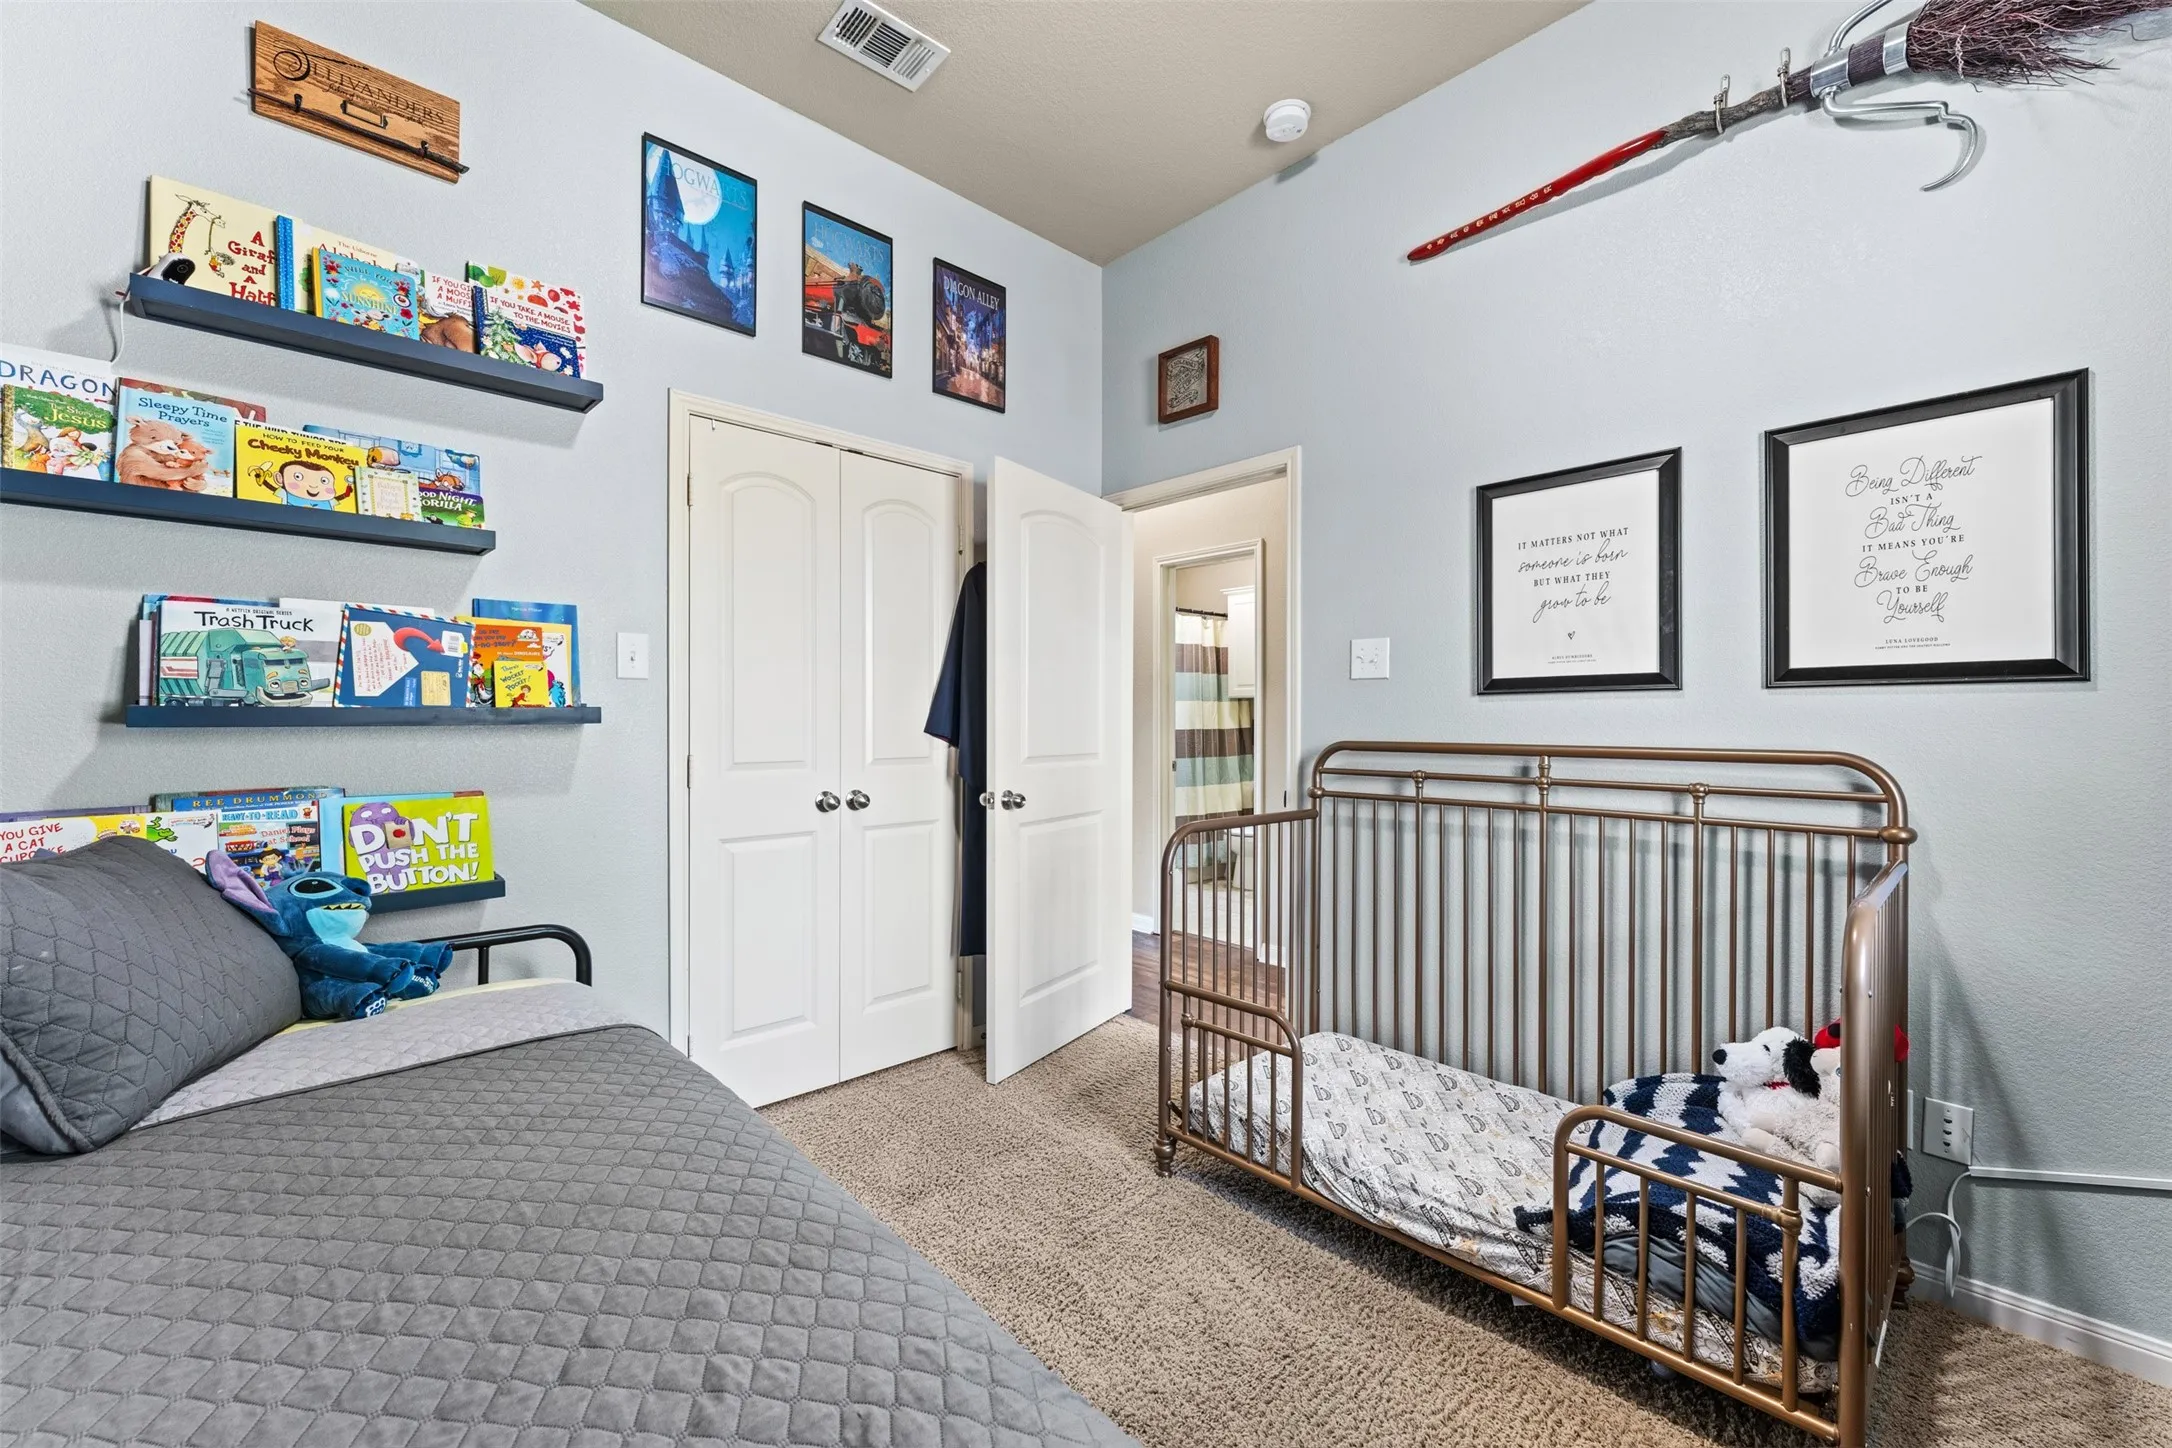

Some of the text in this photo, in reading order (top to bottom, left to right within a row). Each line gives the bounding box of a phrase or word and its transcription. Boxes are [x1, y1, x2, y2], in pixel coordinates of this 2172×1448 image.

[273, 39, 444, 124] OLLIVANDERS
[250, 231, 265, 247] A
[228, 240, 276, 265] Giraf
[242, 264, 266, 276] and
[243, 275, 257, 284] A
[229, 282, 276, 306] Half
[432, 276, 471, 292] IF YOU GI
[446, 288, 471, 300] MOOS
[944, 276, 999, 311] DIAGON ALLEY
[342, 291, 398, 314] SUNSHINE
[446, 295, 472, 307] MUFFI
[490, 296, 498, 304] IF
[500, 299, 516, 308] YOU
[517, 304, 536, 315] TAKE
[544, 312, 570, 325] MOUSE
[524, 315, 540, 324] THE
[541, 320, 570, 334] MOVIES
[0, 360, 116, 397] DRAGON
[44, 408, 107, 429] Jesus
[66, 405, 93, 418] Story
[138, 397, 228, 423] Sleepy Time
[158, 410, 210, 427] Prayers
[262, 433, 284, 442] HOW
[301, 441, 321, 449] FEED
[324, 444, 344, 453] YOUR
[247, 439, 359, 470] Cheeky Monkey
[1845, 455, 1983, 497] Being Different
[419, 497, 462, 511] ORILLA
[1890, 494, 1920, 505] ISN'T
[1865, 502, 1961, 539] Bad Thing
[1518, 527, 1629, 550] IT MATTERS NOT WHAT
[1878, 540, 1916, 551] MEANS
[1921, 534, 1964, 546] YOU'RE
[1518, 538, 1629, 573] someone is born
[1534, 571, 1610, 587] BUT WHAT THEY
[1854, 549, 1973, 588] Brave Enough
[1532, 581, 1612, 623] grow to be
[1876, 590, 1949, 624] Yourself
[194, 611, 314, 632] Trash Truck
[192, 792, 328, 807] REE DRUMMOND
[0, 823, 63, 841] YOU GIVE
[261, 828, 290, 837] Daniel
[291, 826, 316, 834] Plays
[280, 835, 310, 844] School
[4, 837, 45, 853] A CAT
[358, 842, 479, 873] PUSH THE
[366, 861, 480, 895] BUTTON!
